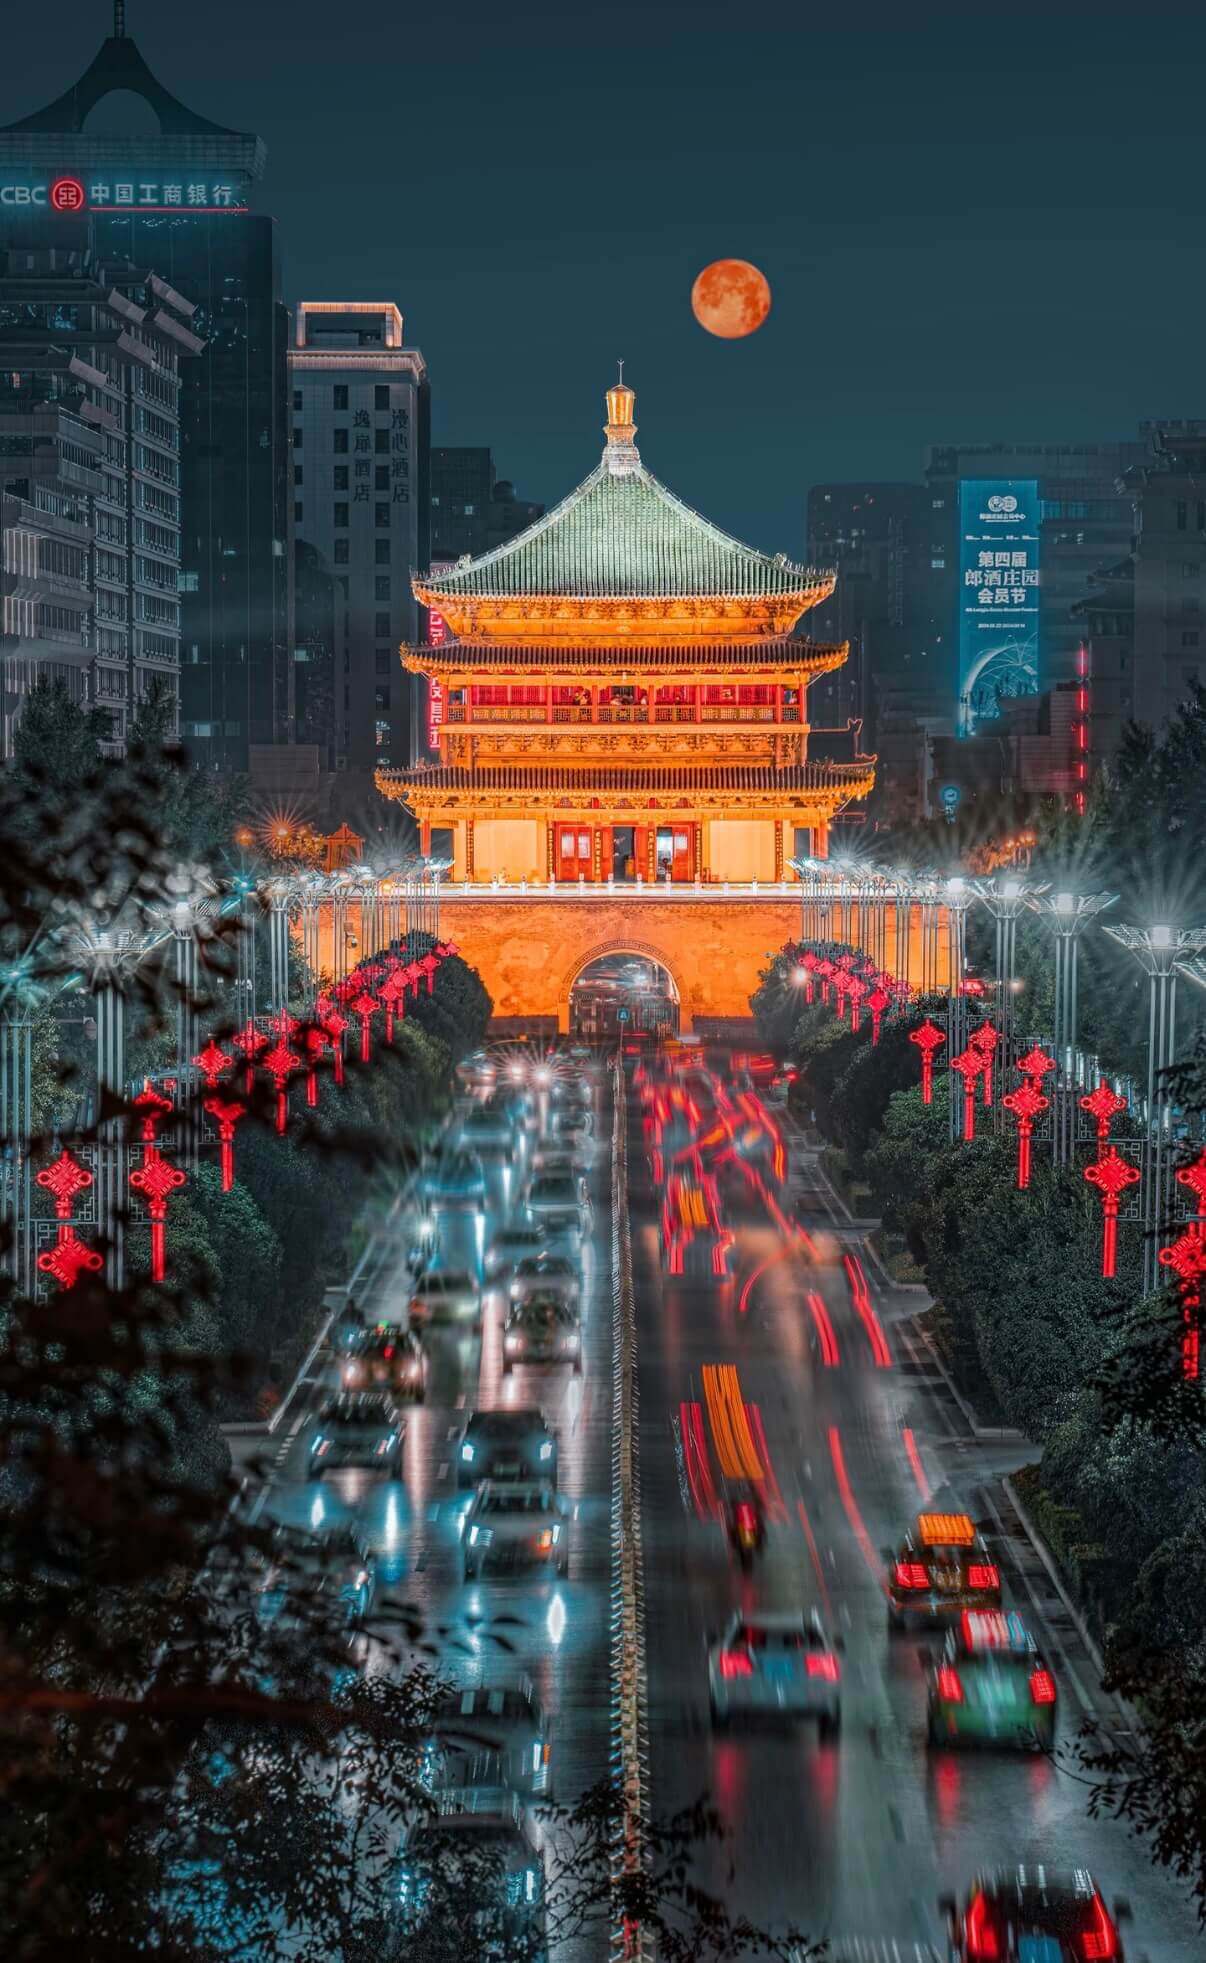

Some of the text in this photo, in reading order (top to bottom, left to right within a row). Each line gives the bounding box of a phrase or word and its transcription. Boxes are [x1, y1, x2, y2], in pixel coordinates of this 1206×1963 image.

[91, 182, 233, 206] 中国工商银行
[391, 408, 409, 503] 漫心酒店
[978, 551, 1027, 568] 第四届
[965, 569, 1039, 587] 郎酒庄园
[978, 588, 1027, 604] 会员节
